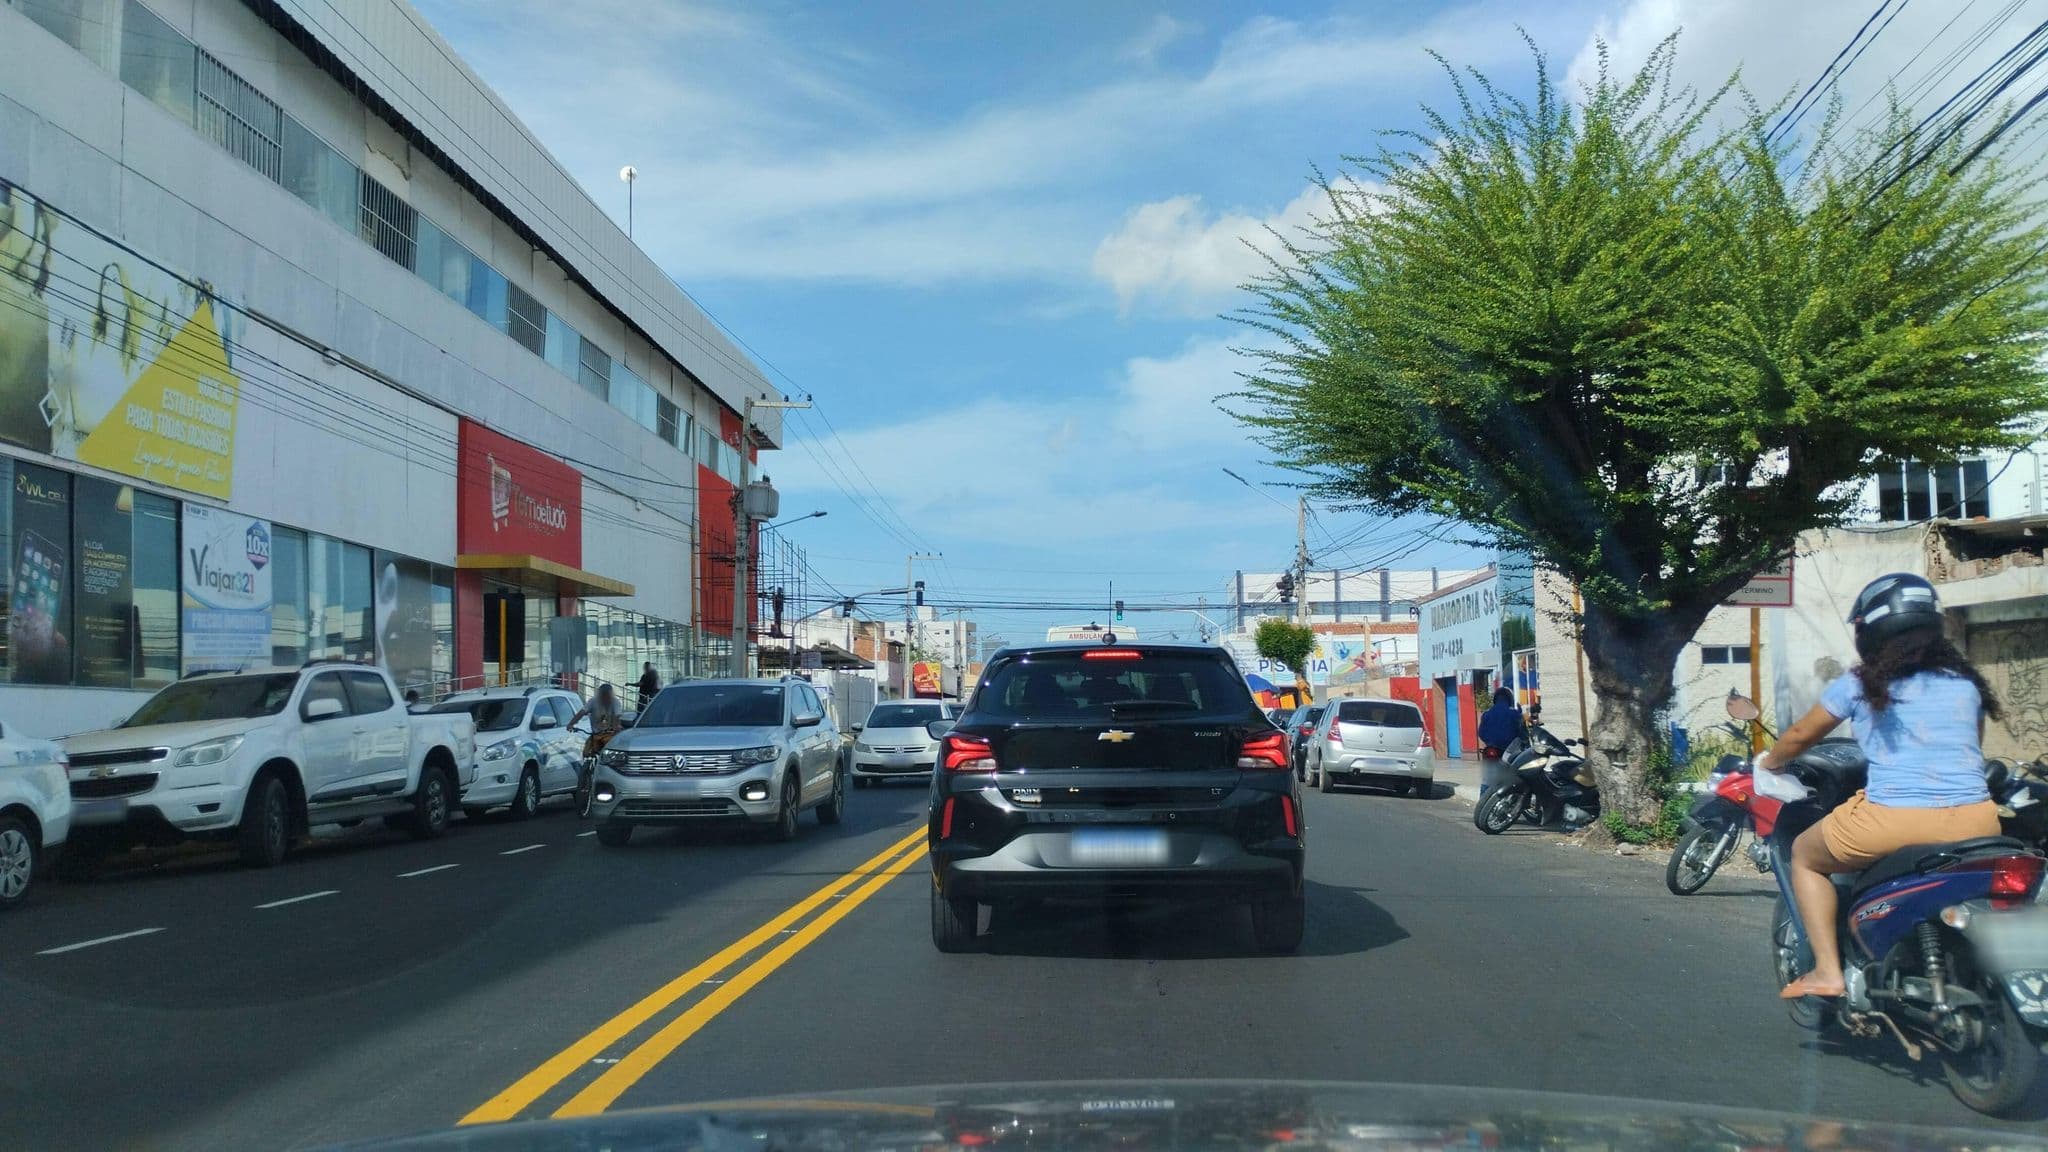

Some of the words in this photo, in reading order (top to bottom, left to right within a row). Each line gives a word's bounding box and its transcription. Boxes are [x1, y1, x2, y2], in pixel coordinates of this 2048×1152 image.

[127, 402, 153, 432] PARA
[156, 413, 185, 443] TODAS
[247, 533, 269, 557] 10x
[1068, 632, 1107, 640] AMBULAN
